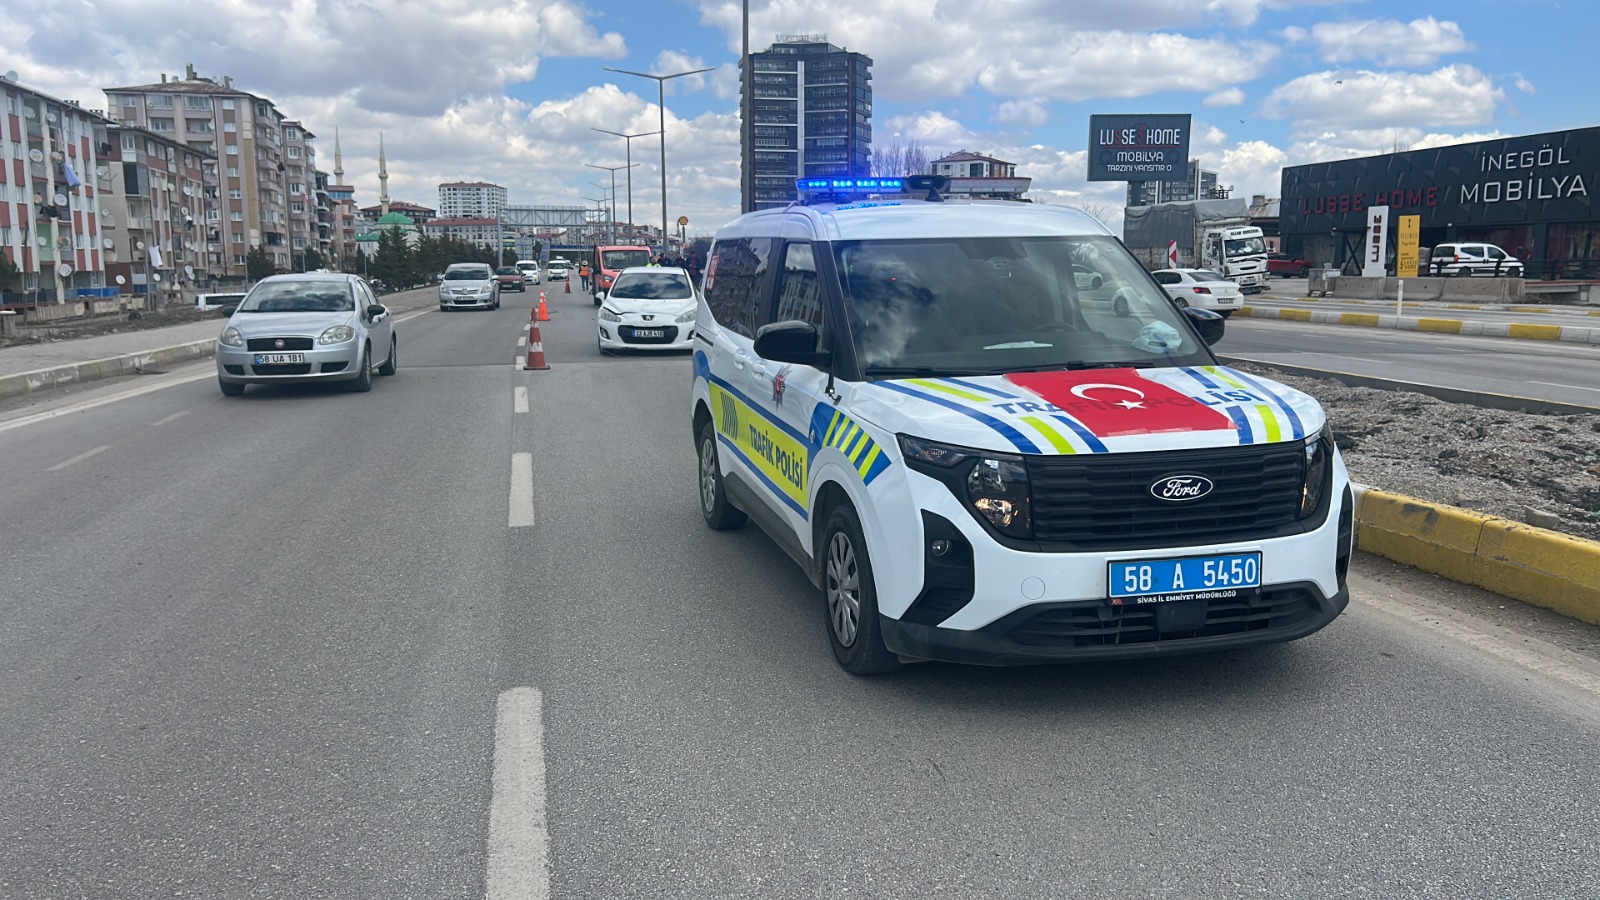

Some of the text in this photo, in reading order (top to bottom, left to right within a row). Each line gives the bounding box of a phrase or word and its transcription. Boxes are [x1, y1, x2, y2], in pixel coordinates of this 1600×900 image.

[1100, 129, 1180, 145] LUSSE HOME
[1481, 143, 1570, 172] İNEGÖL
[1303, 187, 1439, 214] LUSSE HOME
[1460, 171, 1587, 204] MOBİLYA
[288, 354, 301, 362] 181
[749, 424, 803, 491] TRAFİK POLİSİ
[1163, 479, 1201, 497] Ford
[1124, 558, 1256, 592] 58 A 5450
[1137, 596, 1157, 604] SİVAS
[1166, 593, 1194, 602] EMNİYET
[1195, 590, 1236, 600] MÜDÜRLÜĞÜ
